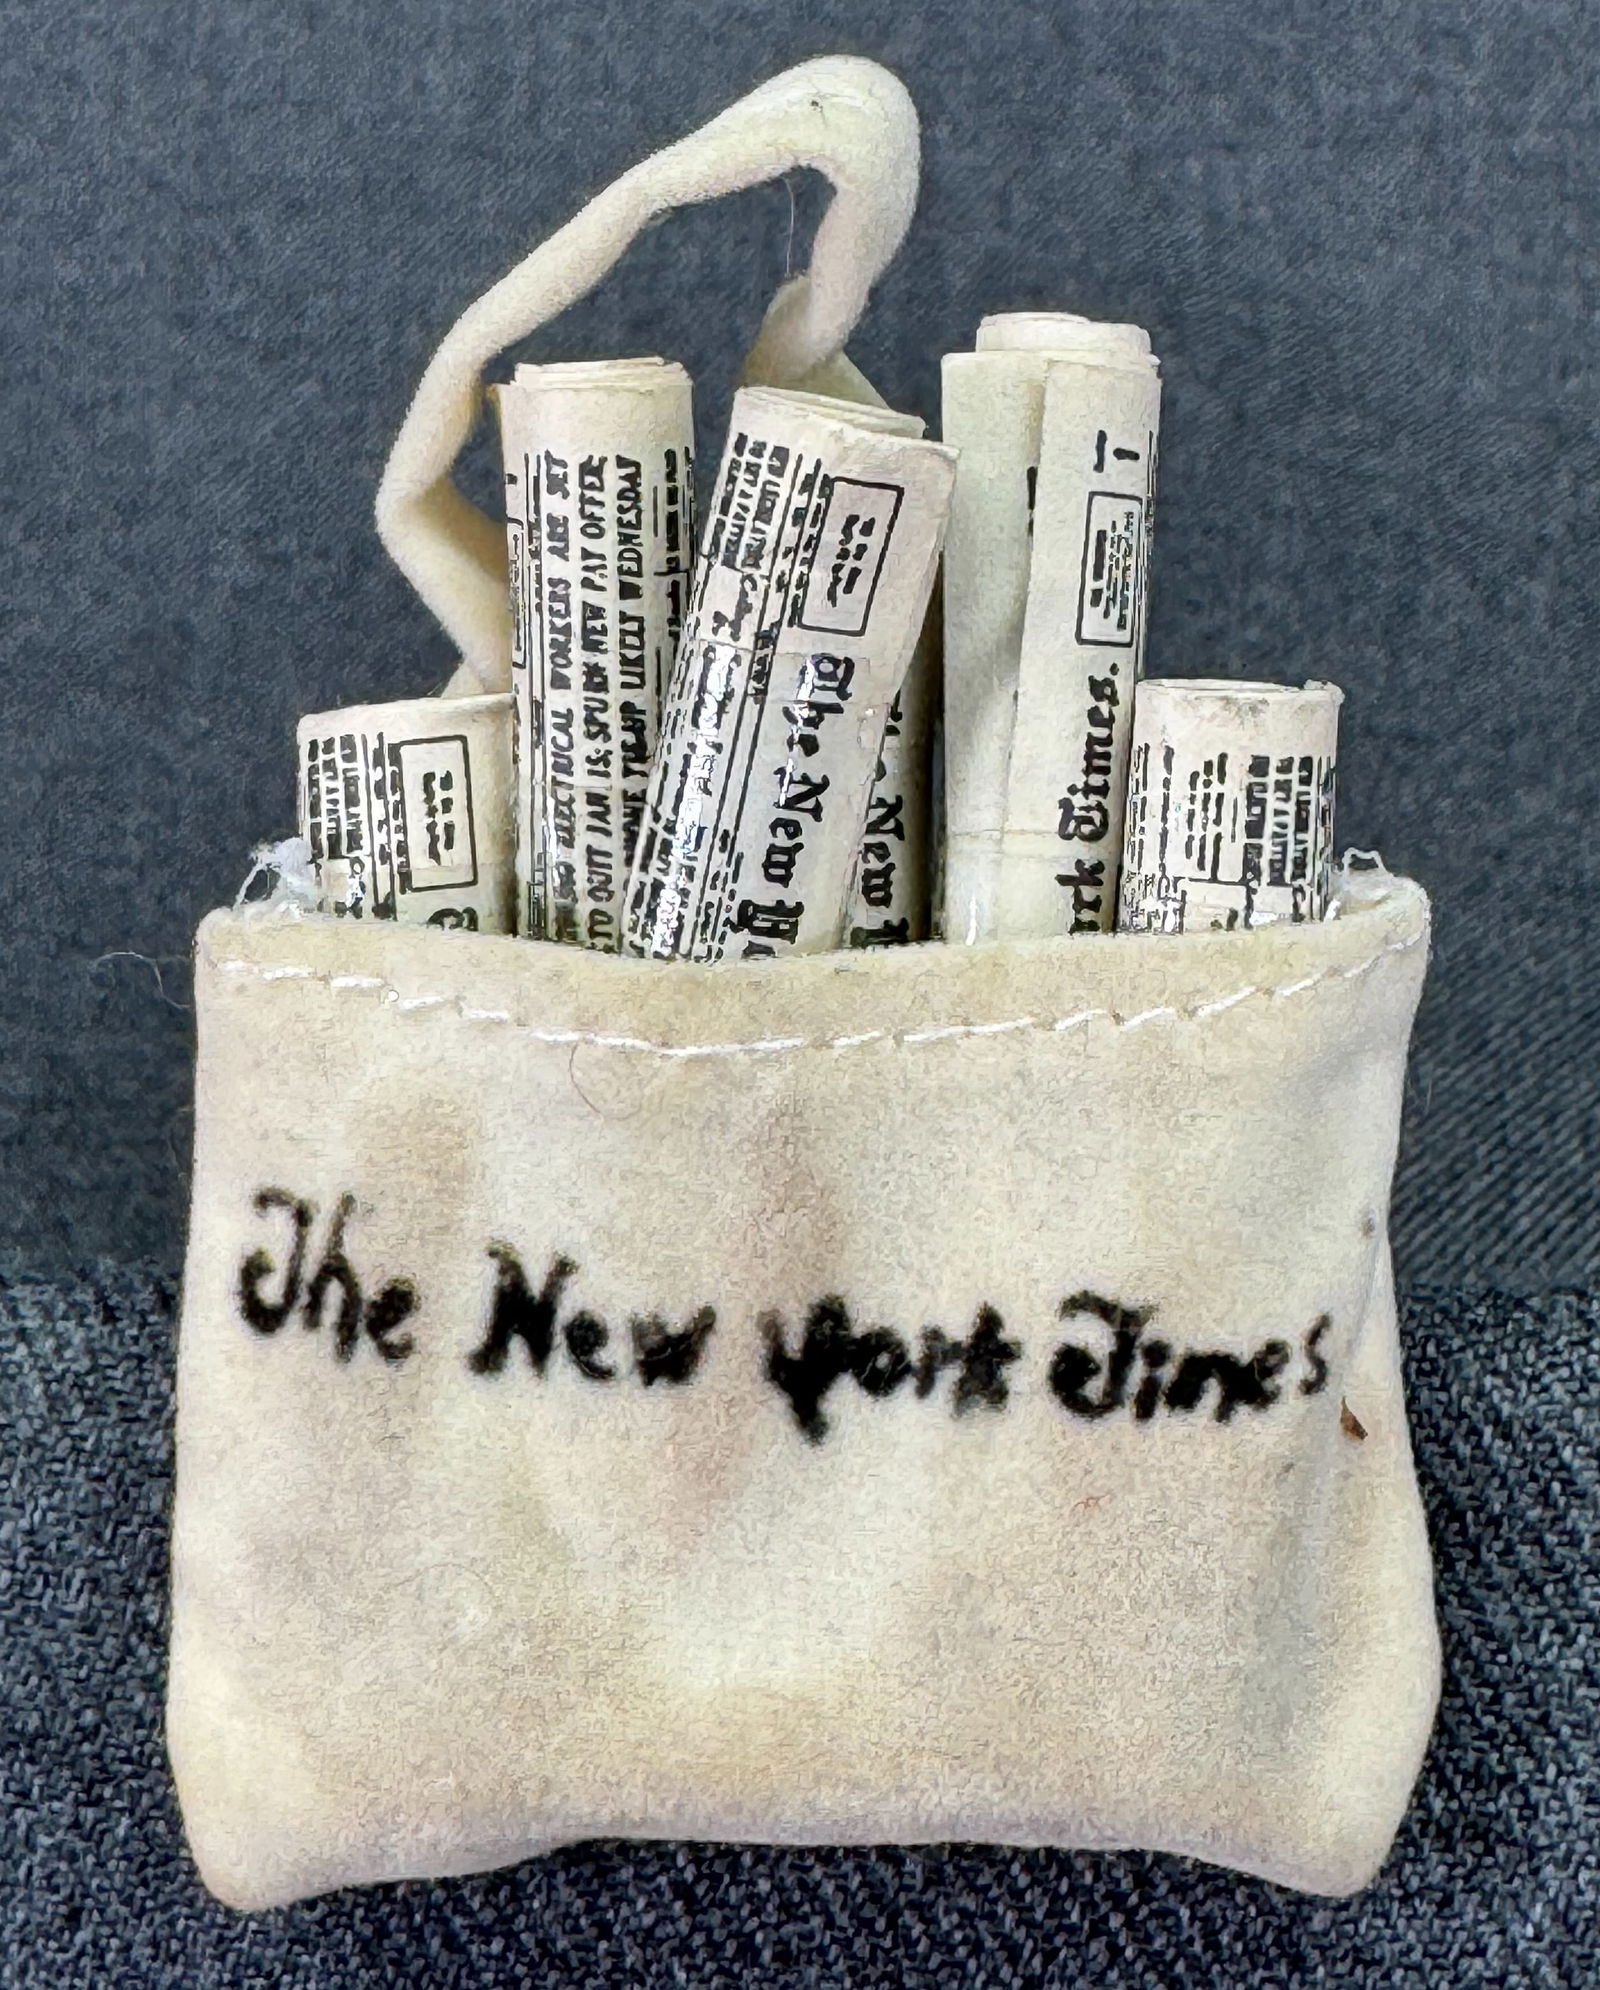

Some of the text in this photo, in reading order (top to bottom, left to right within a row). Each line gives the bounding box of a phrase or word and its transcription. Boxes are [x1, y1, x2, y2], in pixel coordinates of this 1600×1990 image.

[544, 449, 571, 501] SET
[614, 454, 643, 601] WEDNESDAY
[547, 577, 573, 691] WORKERS
[762, 758, 830, 888] New
[861, 794, 906, 907] New
[239, 1185, 416, 1361] The
[467, 1239, 718, 1386] New
